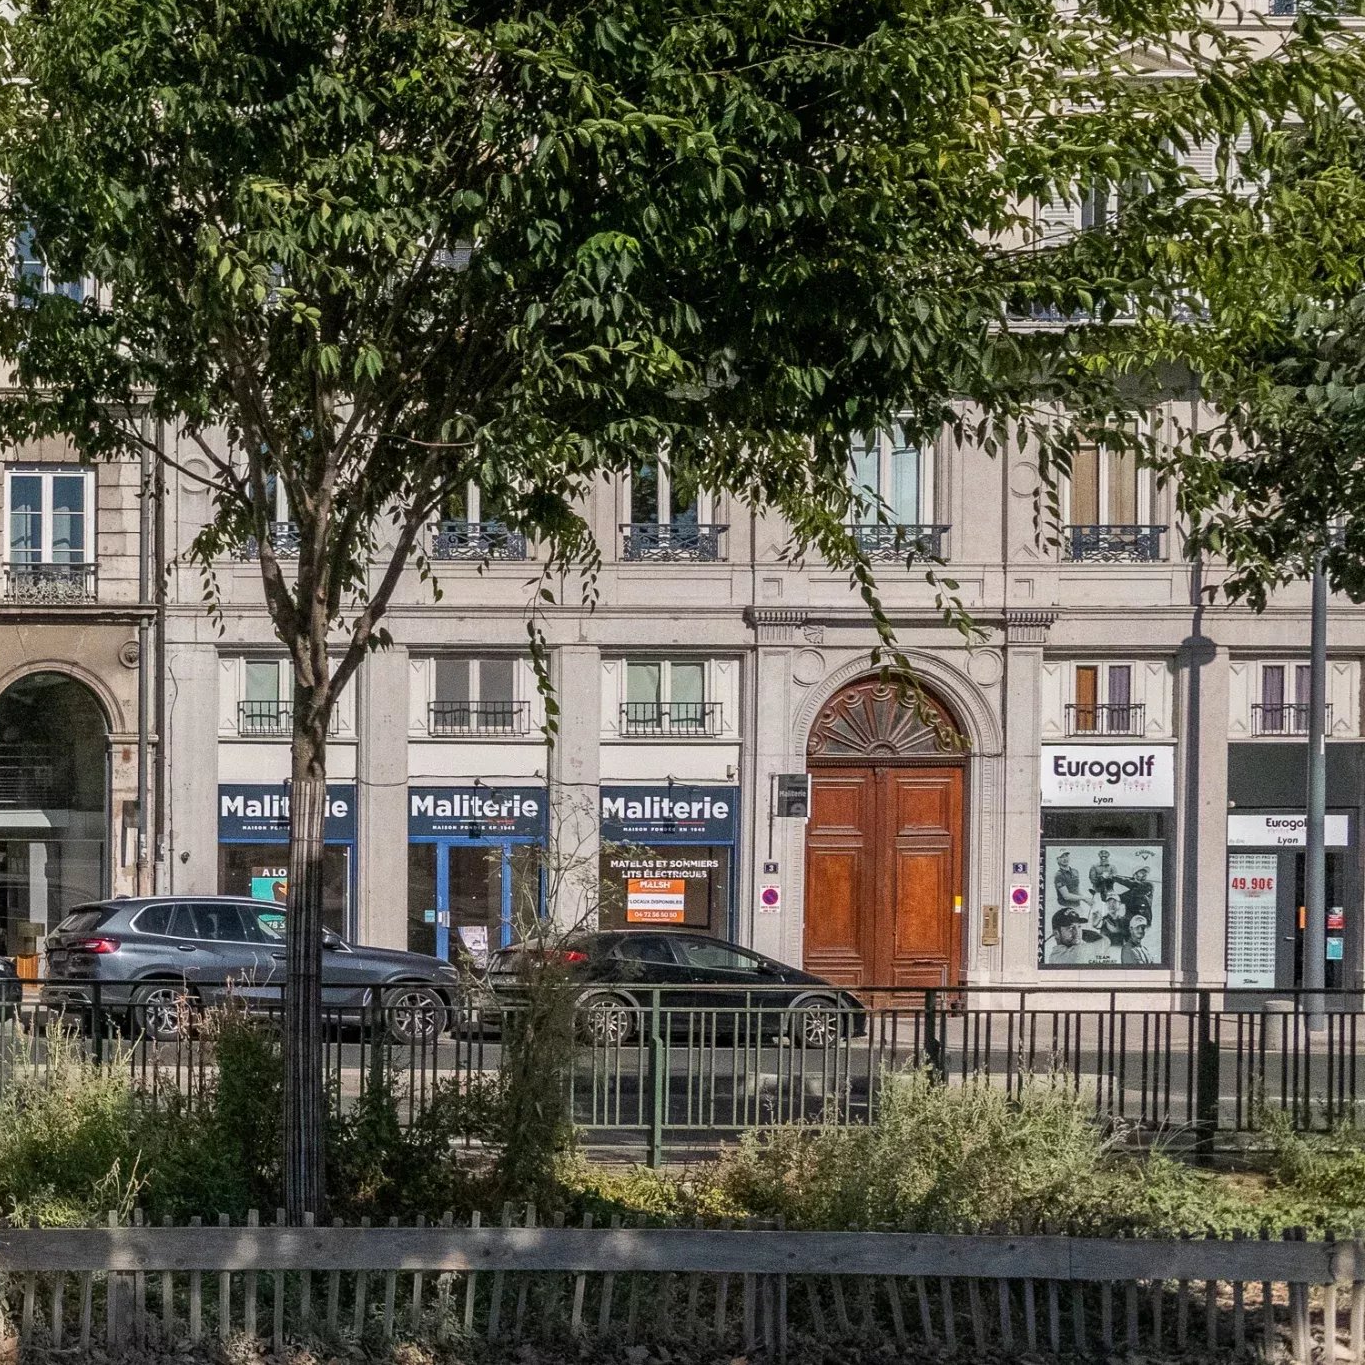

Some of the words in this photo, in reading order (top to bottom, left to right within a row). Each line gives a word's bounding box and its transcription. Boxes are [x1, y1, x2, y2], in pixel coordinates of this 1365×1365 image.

[1053, 754, 1155, 784] Eurogolf
[221, 795, 349, 817] Malitie
[411, 794, 539, 816] Maliterie
[602, 796, 729, 818] Maliterie
[1093, 796, 1113, 805] Lyon
[1266, 818, 1307, 830] Eurogol
[1277, 836, 1298, 846] Lyon
[1232, 878, 1273, 890] 49.90€
